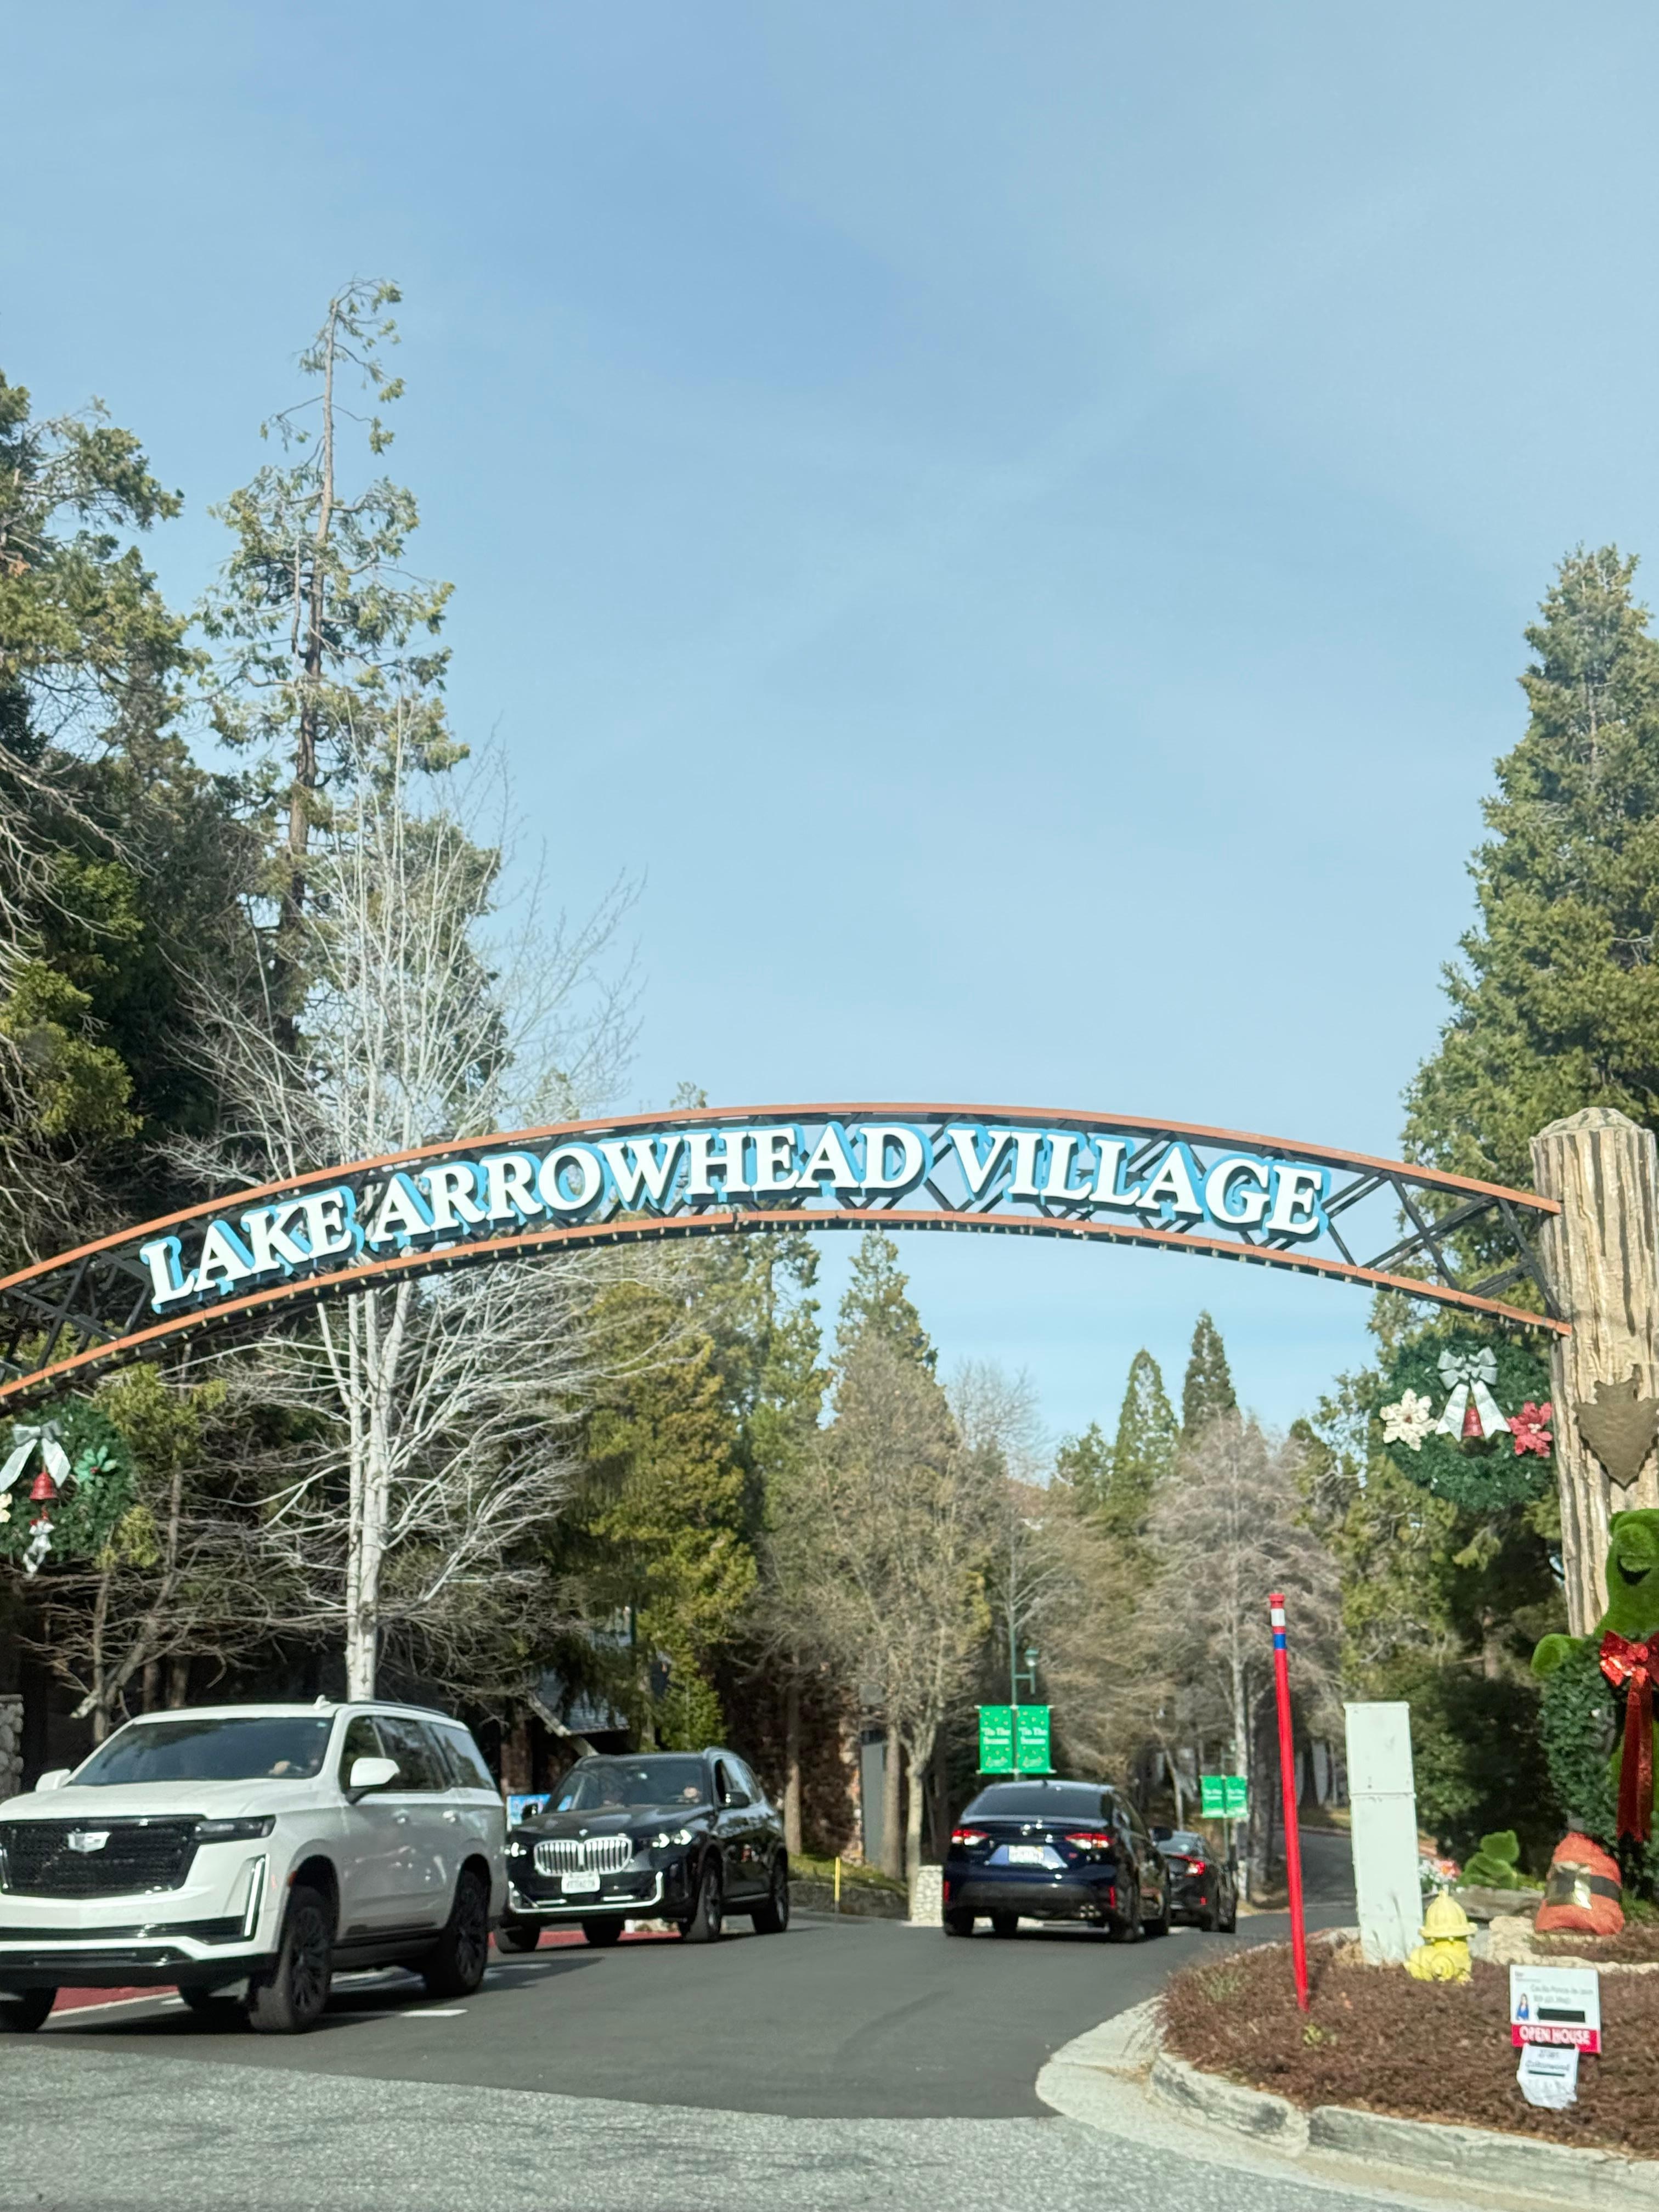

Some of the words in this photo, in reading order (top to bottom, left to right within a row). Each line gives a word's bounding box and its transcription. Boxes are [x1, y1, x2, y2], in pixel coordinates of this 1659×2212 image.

[141, 1187, 356, 1308] LAKE
[370, 1125, 926, 1244] ARROWHEAD
[946, 1127, 1325, 1235] VILLAGE
[1519, 2025, 1551, 2043] OPEN
[1551, 2028, 1590, 2045] HOUSE
